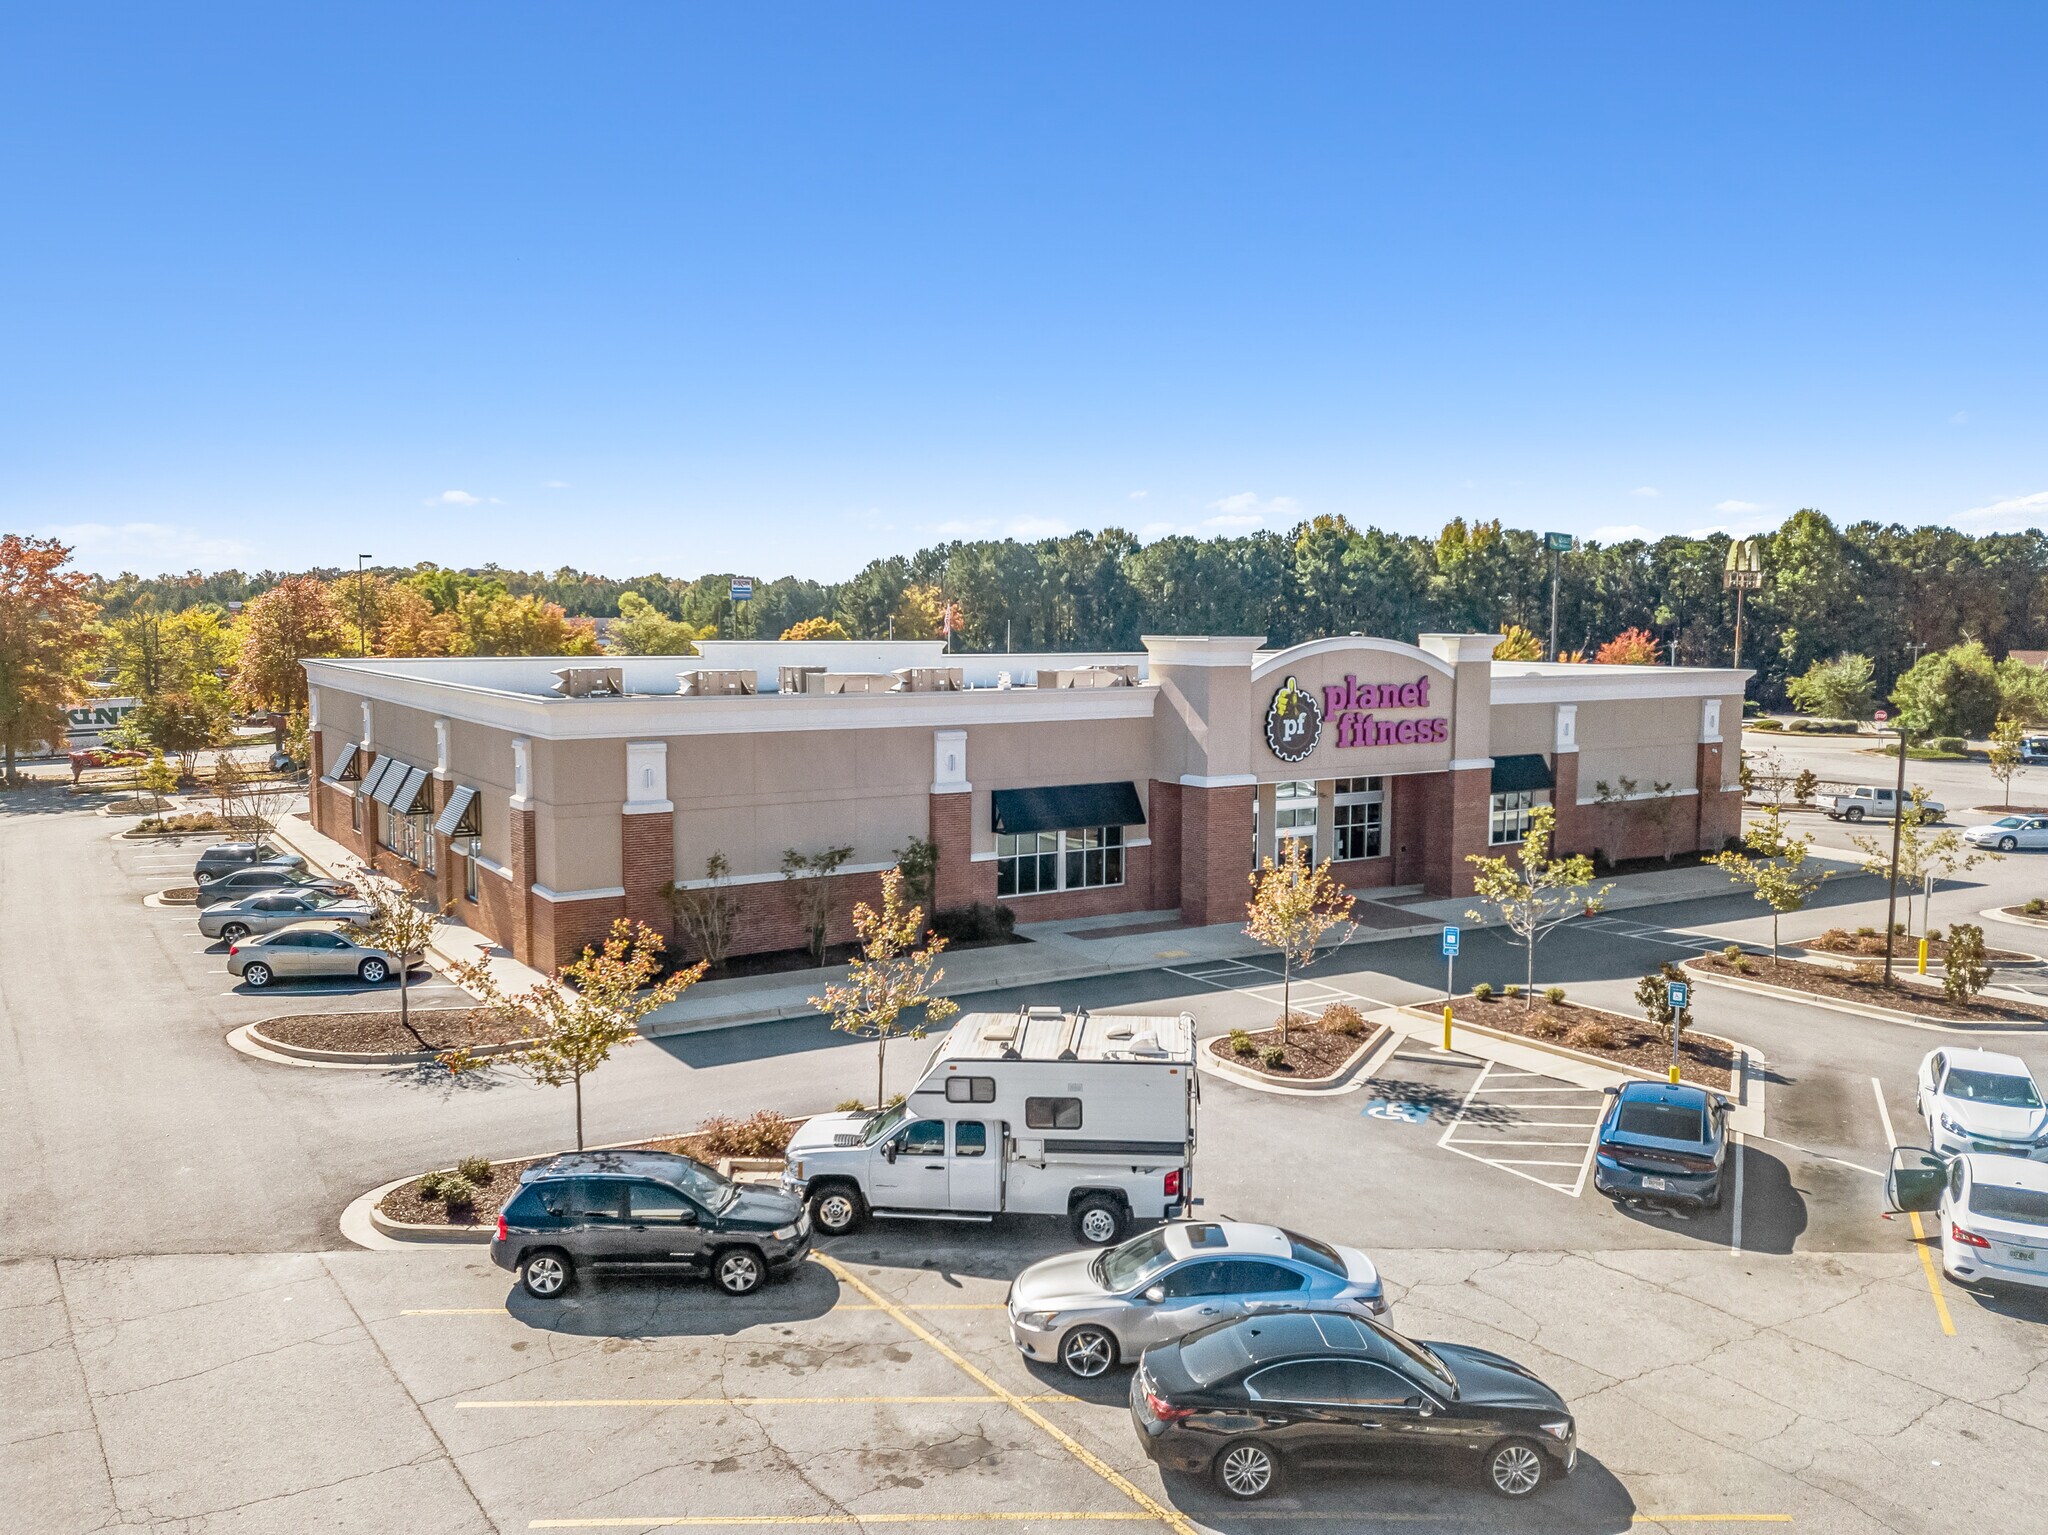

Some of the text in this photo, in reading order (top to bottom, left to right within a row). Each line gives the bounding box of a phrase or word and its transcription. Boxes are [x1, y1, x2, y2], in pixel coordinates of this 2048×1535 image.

[1323, 675, 1430, 722] planet
[1282, 712, 1307, 742] pf
[1336, 712, 1448, 748] fitness
